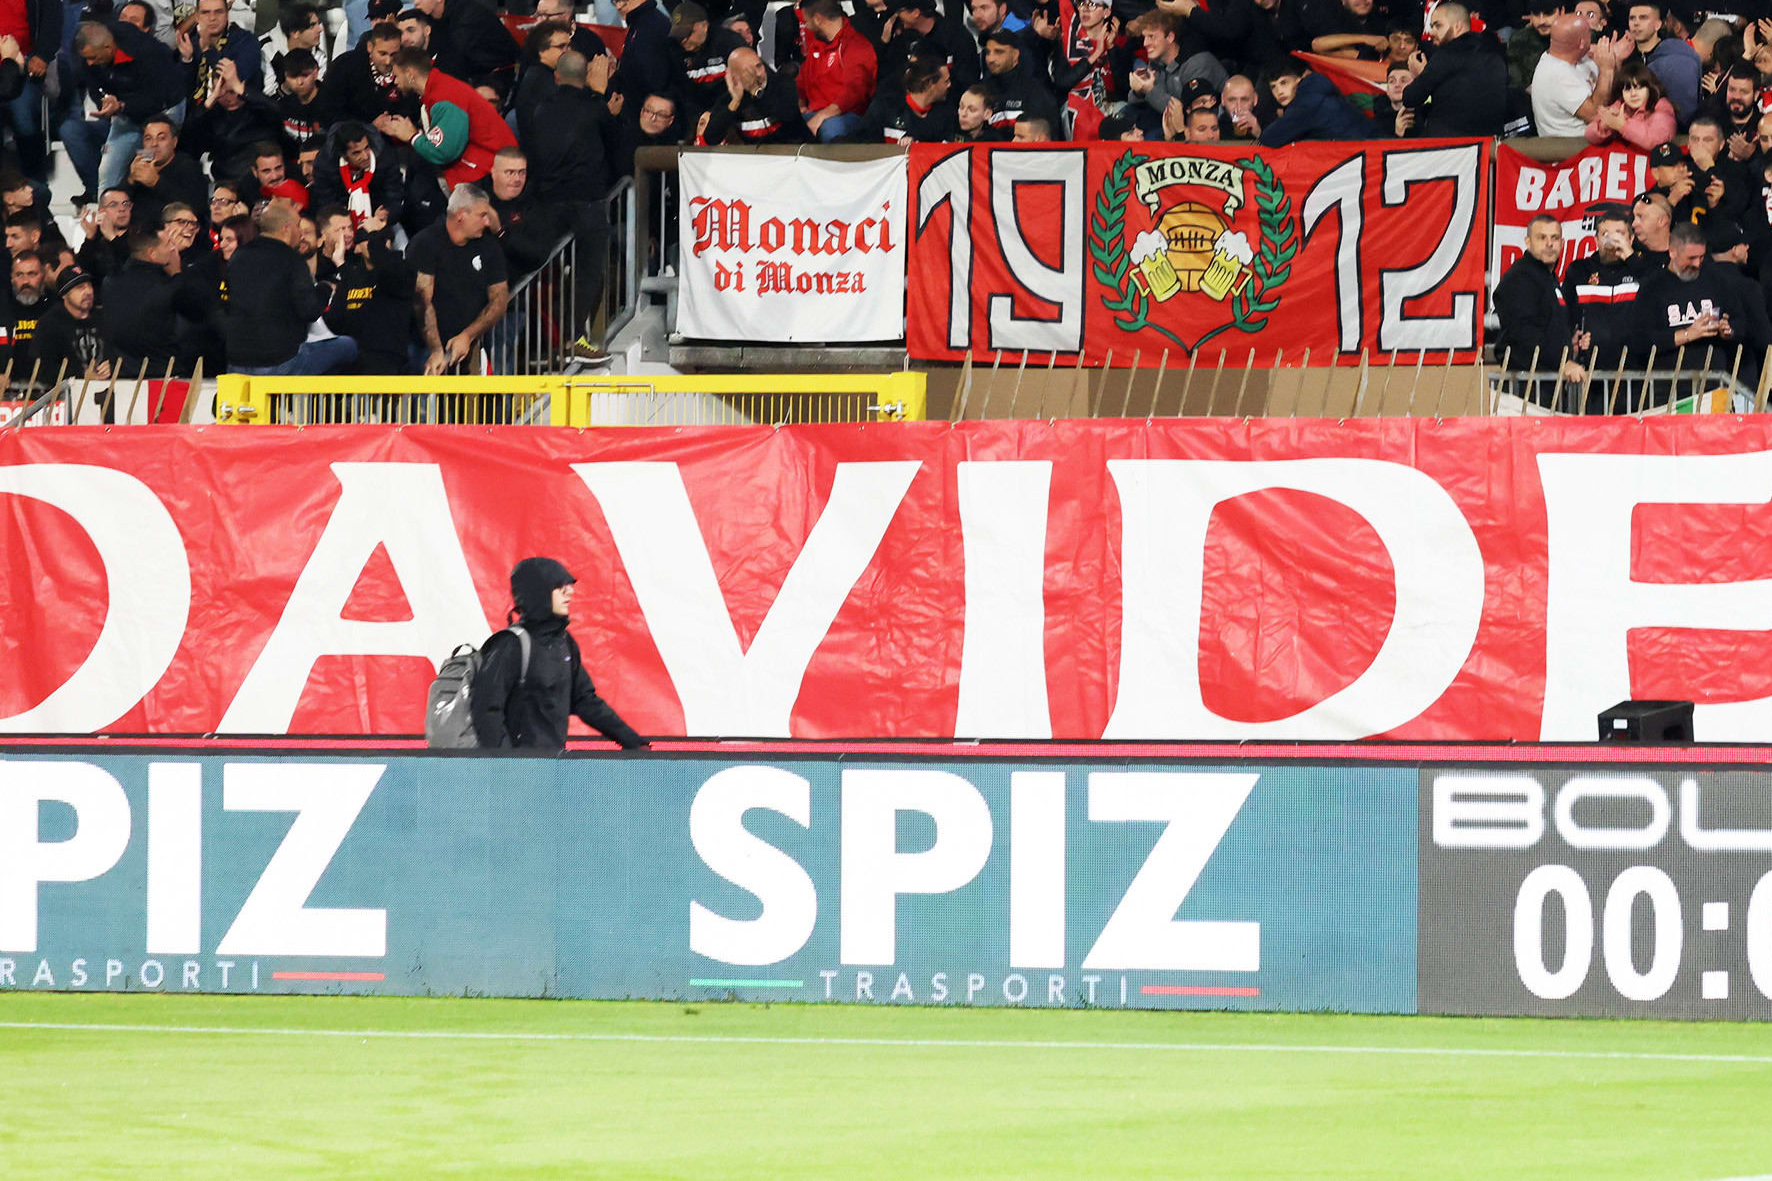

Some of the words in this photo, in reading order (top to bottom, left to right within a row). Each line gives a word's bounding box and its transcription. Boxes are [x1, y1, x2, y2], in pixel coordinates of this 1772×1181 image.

[1146, 161, 1234, 188] MONZA
[688, 195, 897, 258] Monaci
[916, 147, 1088, 354] 19
[1303, 143, 1481, 353] 12
[713, 259, 747, 293] di
[755, 259, 867, 298] Monza
[690, 764, 1262, 971] SPIZ
[820, 970, 1127, 1005] TRASPORTI
